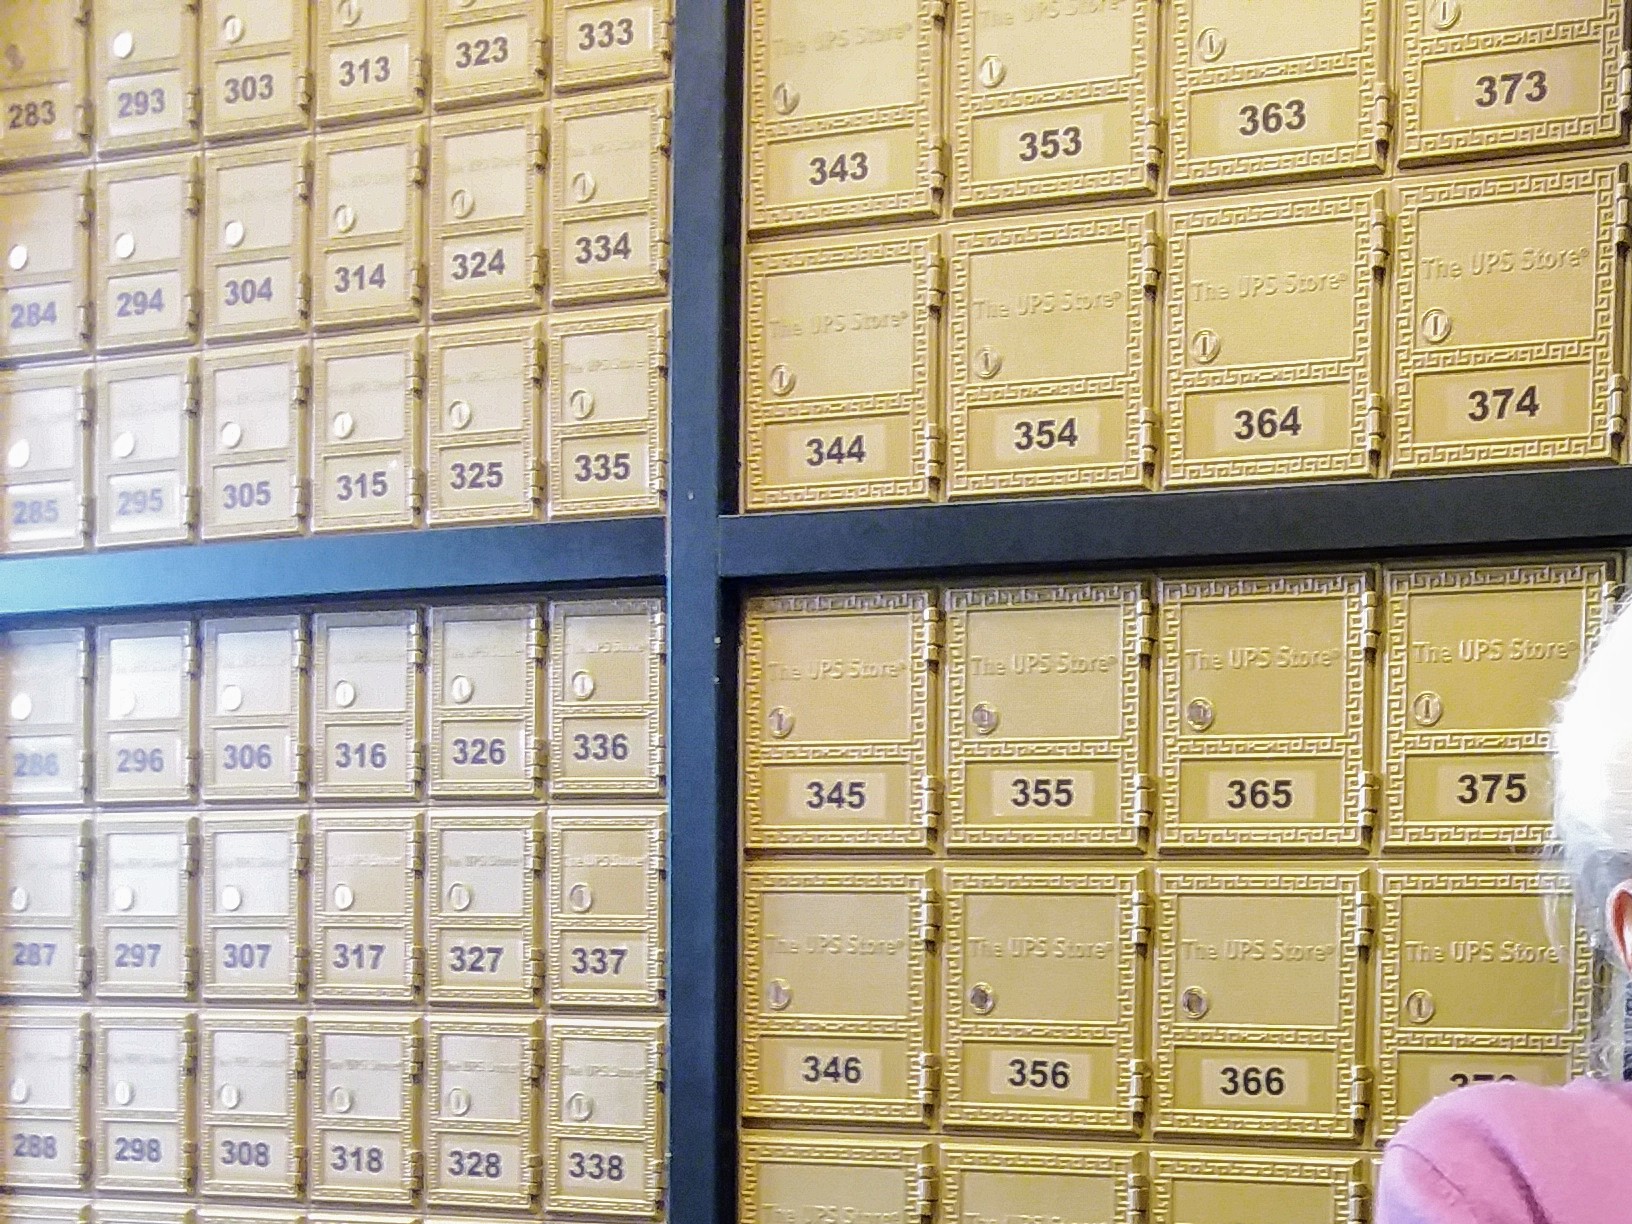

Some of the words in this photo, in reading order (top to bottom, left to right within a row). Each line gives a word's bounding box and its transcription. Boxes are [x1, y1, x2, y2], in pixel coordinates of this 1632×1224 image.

[579, 19, 633, 50] 333
[456, 37, 508, 68] 323
[340, 56, 390, 86] 313
[225, 74, 273, 103] 303
[1476, 71, 1547, 107] 373
[9, 100, 55, 129] 283
[118, 88, 165, 118] 293
[1240, 100, 1305, 135] 363
[1020, 127, 1081, 161] 353
[810, 152, 868, 185] 343
[576, 233, 631, 264] 334
[335, 264, 385, 292] 314
[452, 249, 505, 280] 324
[1421, 257, 1462, 281] The
[1472, 250, 1514, 277] UPS
[225, 277, 272, 306] 304
[1191, 280, 1229, 301] The
[1238, 275, 1280, 299] UPS
[8, 302, 57, 329] 284
[117, 288, 164, 317] 294
[1469, 386, 1539, 421] 374
[1015, 418, 1077, 450] 354
[1235, 407, 1301, 439] 364
[807, 436, 865, 466] 344
[451, 462, 502, 489] 325
[575, 453, 630, 481] 335
[223, 481, 271, 509] 305
[337, 471, 387, 500] 315
[118, 488, 163, 515] 295
[1185, 648, 1223, 671] The
[1229, 646, 1271, 670] UPS
[1412, 641, 1452, 664] The
[1458, 639, 1503, 663] UPS
[118, 748, 163, 772] 296
[224, 744, 271, 769] 306
[336, 743, 386, 768] 316
[453, 739, 505, 764] 326
[574, 734, 628, 760] 336
[807, 782, 865, 808] 345
[1012, 779, 1073, 806] 355
[1228, 780, 1291, 808] 365
[1458, 774, 1526, 803] 375
[12, 942, 56, 966] 287
[115, 944, 161, 967] 297
[224, 944, 271, 968] 307
[333, 944, 384, 969] 317
[450, 947, 503, 972] 327
[572, 948, 626, 974] 337
[1181, 938, 1218, 961] The
[1225, 938, 1265, 961] UPS
[1404, 940, 1446, 963] The
[1451, 940, 1495, 963] UPS
[804, 1056, 861, 1083] 346
[1009, 1059, 1069, 1088] 356
[1221, 1068, 1284, 1095] 366
[115, 1138, 161, 1162] 298
[222, 1141, 269, 1167] 308
[331, 1146, 382, 1172] 318
[449, 1151, 500, 1178] 328
[570, 1153, 623, 1181] 338
